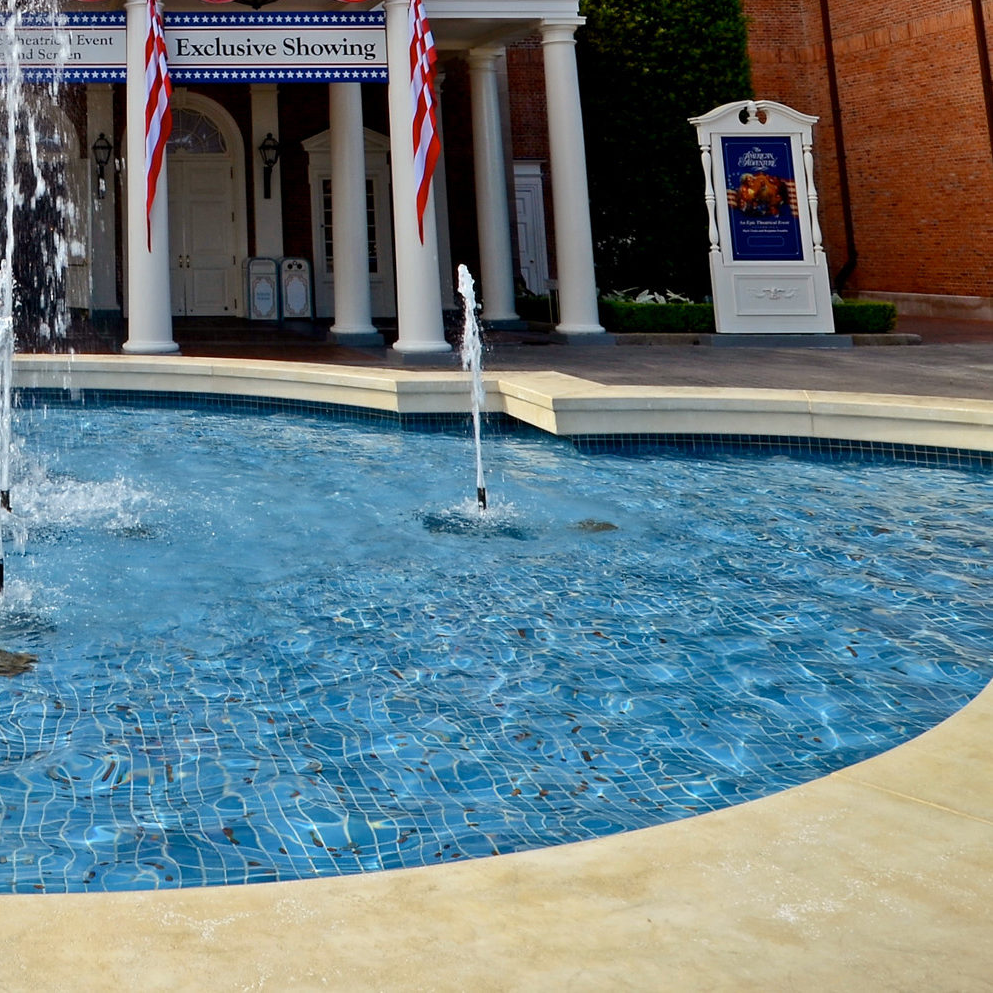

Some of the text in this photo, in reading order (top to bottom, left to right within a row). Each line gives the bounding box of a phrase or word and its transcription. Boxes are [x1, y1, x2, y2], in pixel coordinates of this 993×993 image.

[77, 34, 113, 46] Event
[38, 49, 81, 60] Scren
[175, 37, 376, 60] Exclusive Showing
